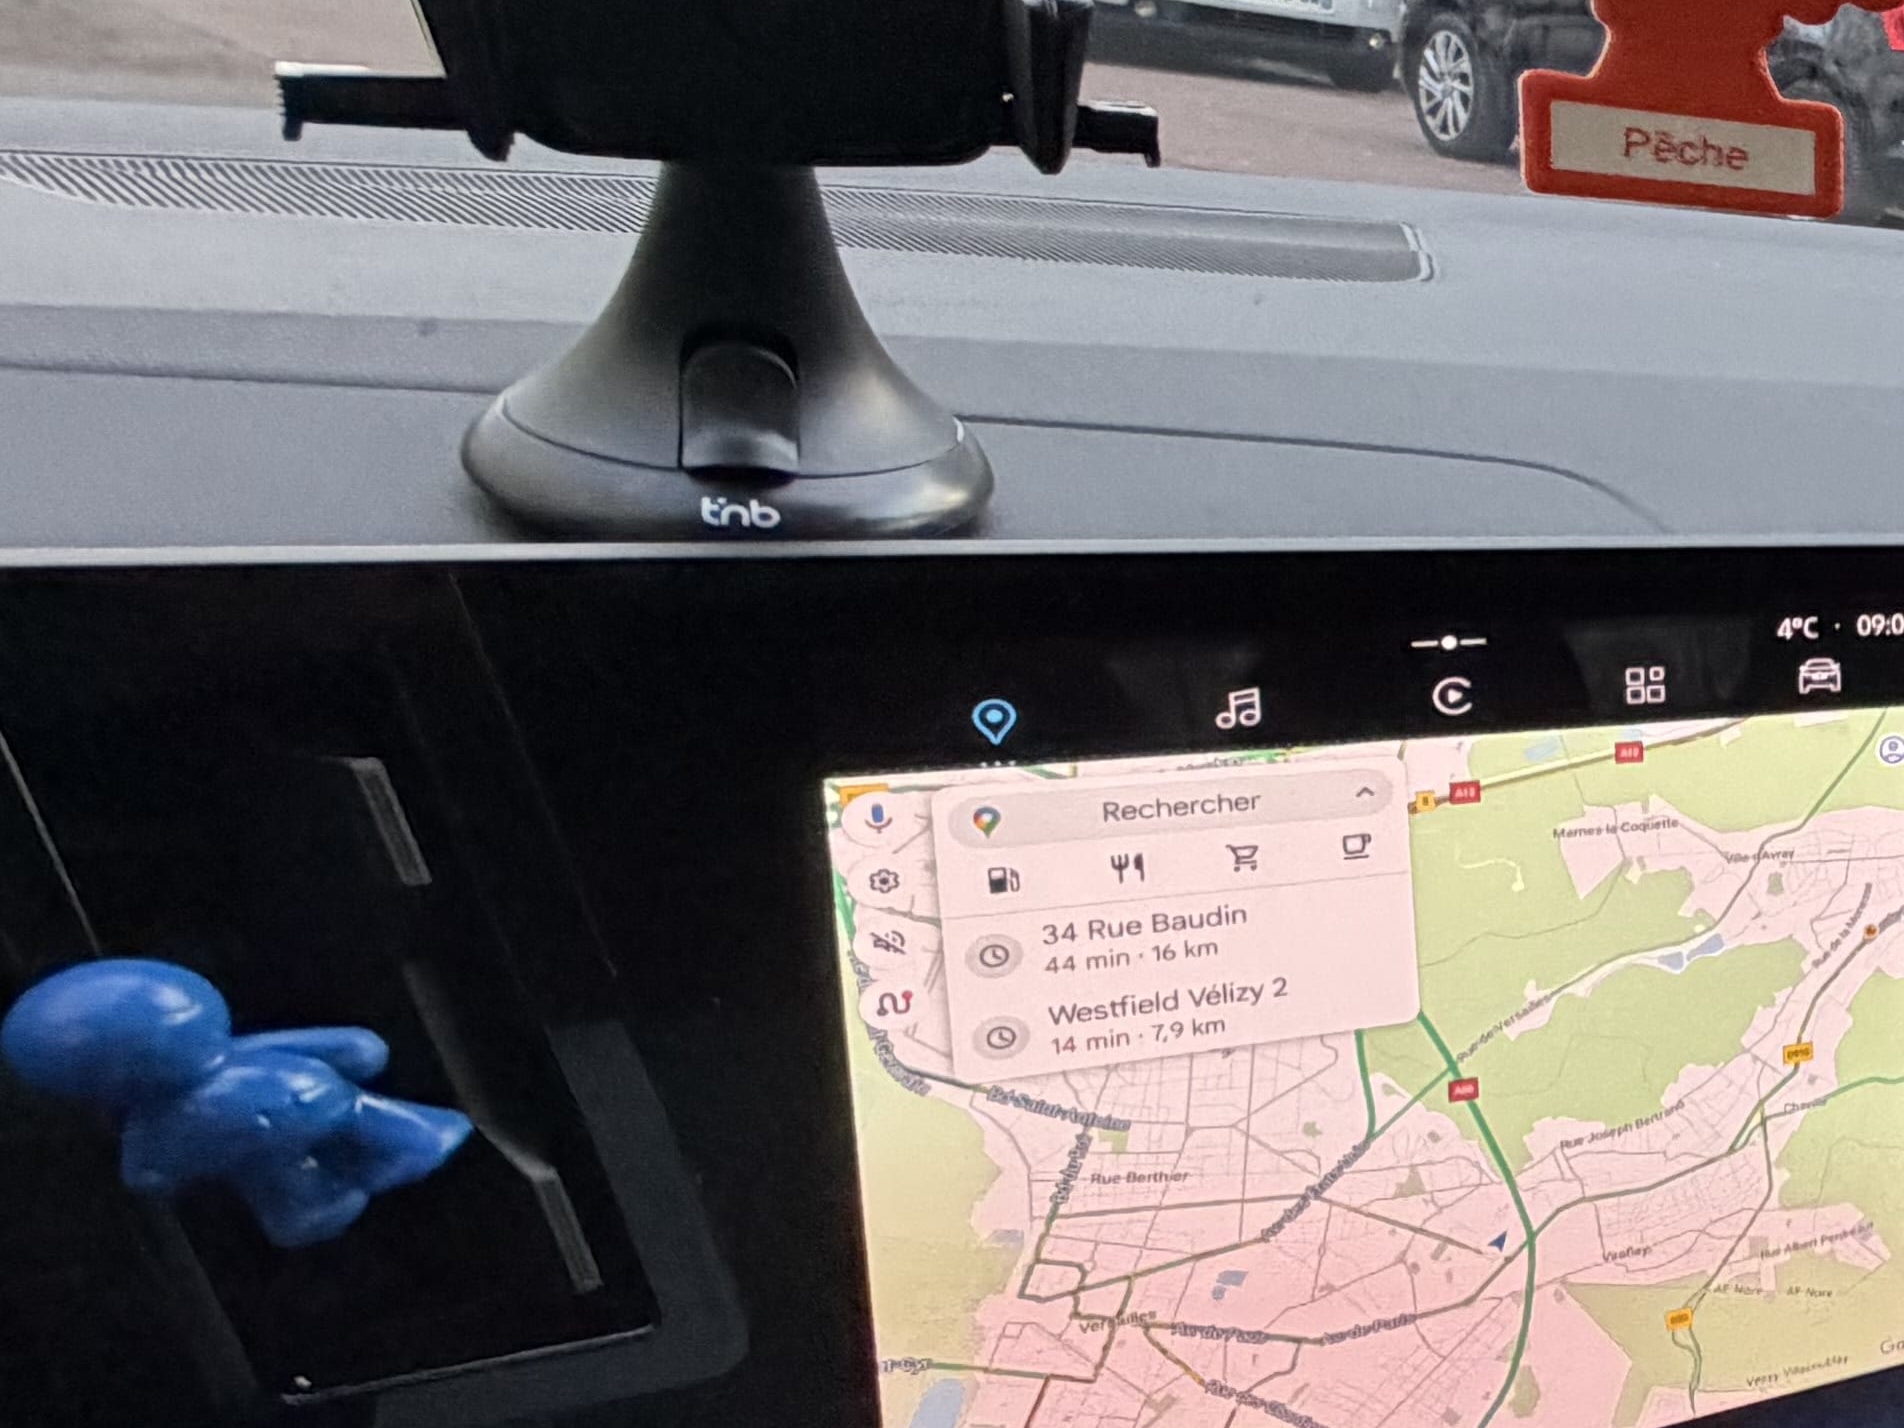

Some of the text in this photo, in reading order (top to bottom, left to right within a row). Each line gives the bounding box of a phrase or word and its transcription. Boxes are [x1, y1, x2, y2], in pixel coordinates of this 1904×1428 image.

[1622, 124, 1751, 172] Pêche
[1102, 791, 1262, 823] Rechercher
[1042, 905, 1248, 946] 34 Rue Baudin
[1044, 939, 1219, 974] 44 min 16 km
[1049, 977, 1289, 1026] Westfield Vélizy 2
[1052, 1016, 1226, 1056] 14 min 7,9 km
